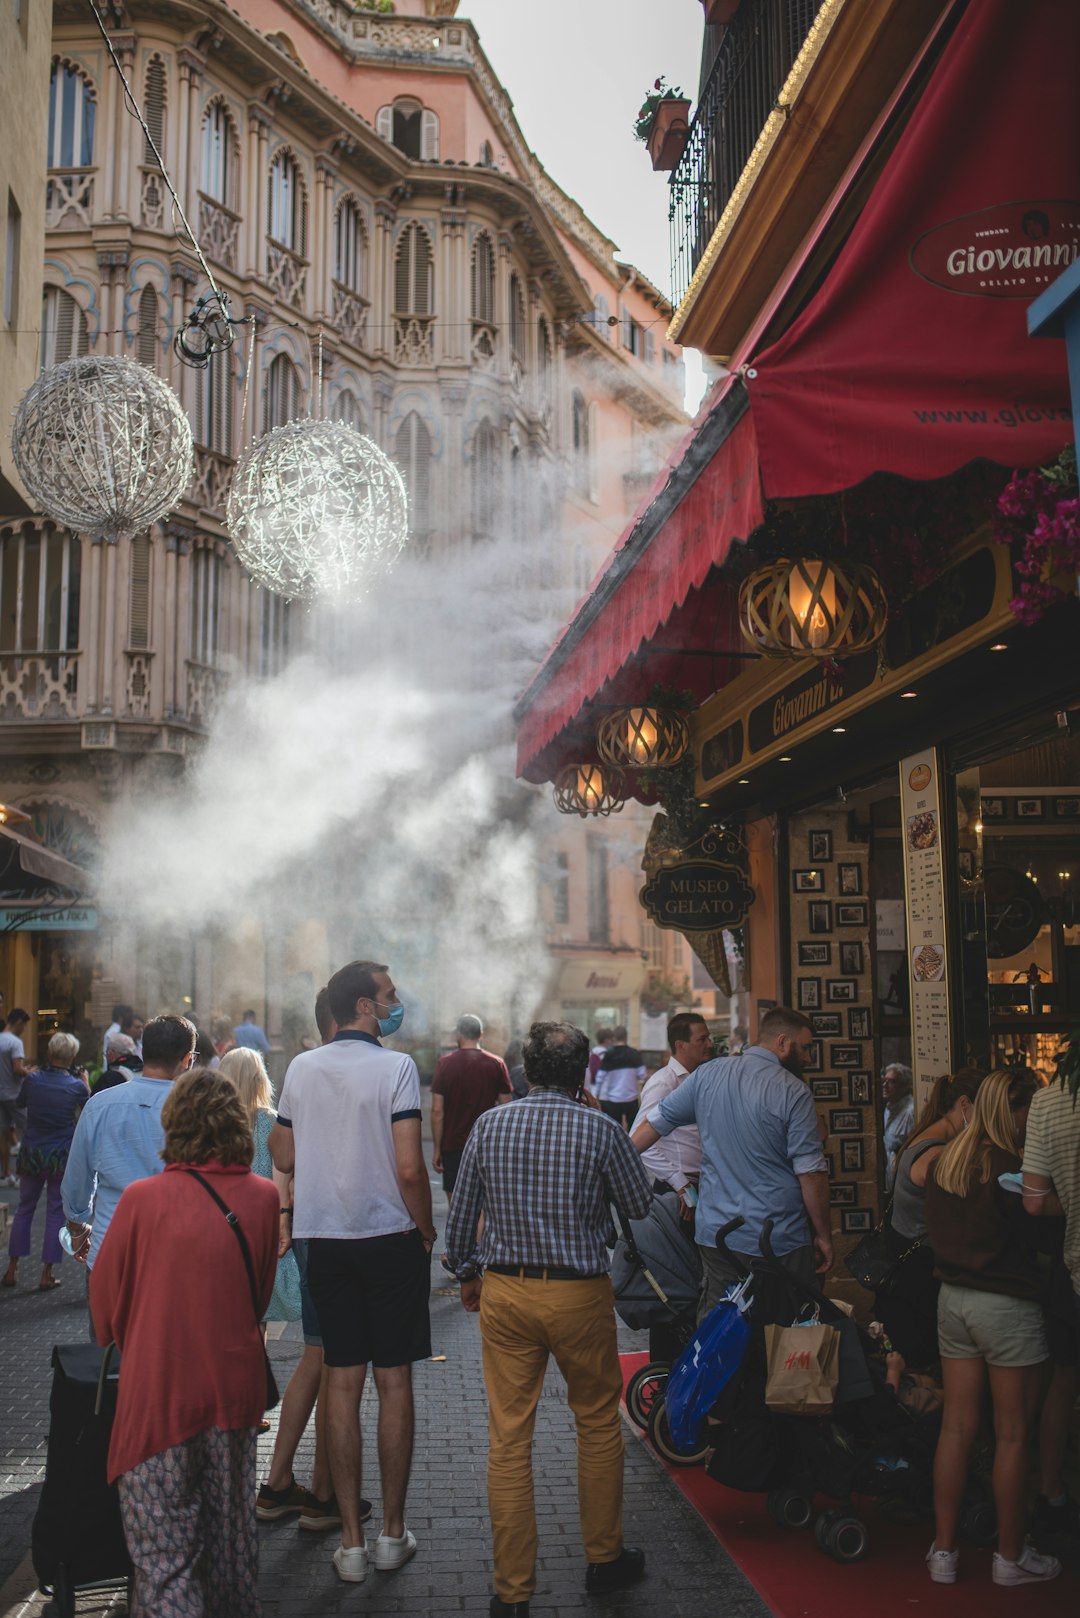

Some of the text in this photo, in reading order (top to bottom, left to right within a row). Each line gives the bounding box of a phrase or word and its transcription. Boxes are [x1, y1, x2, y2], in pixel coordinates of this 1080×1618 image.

[946, 238, 1080, 276] Giovanni
[979, 278, 1026, 287] GELATO
[772, 667, 829, 737] Giovanni
[670, 880, 729, 893] MUSEO
[665, 900, 734, 914] GELATO
